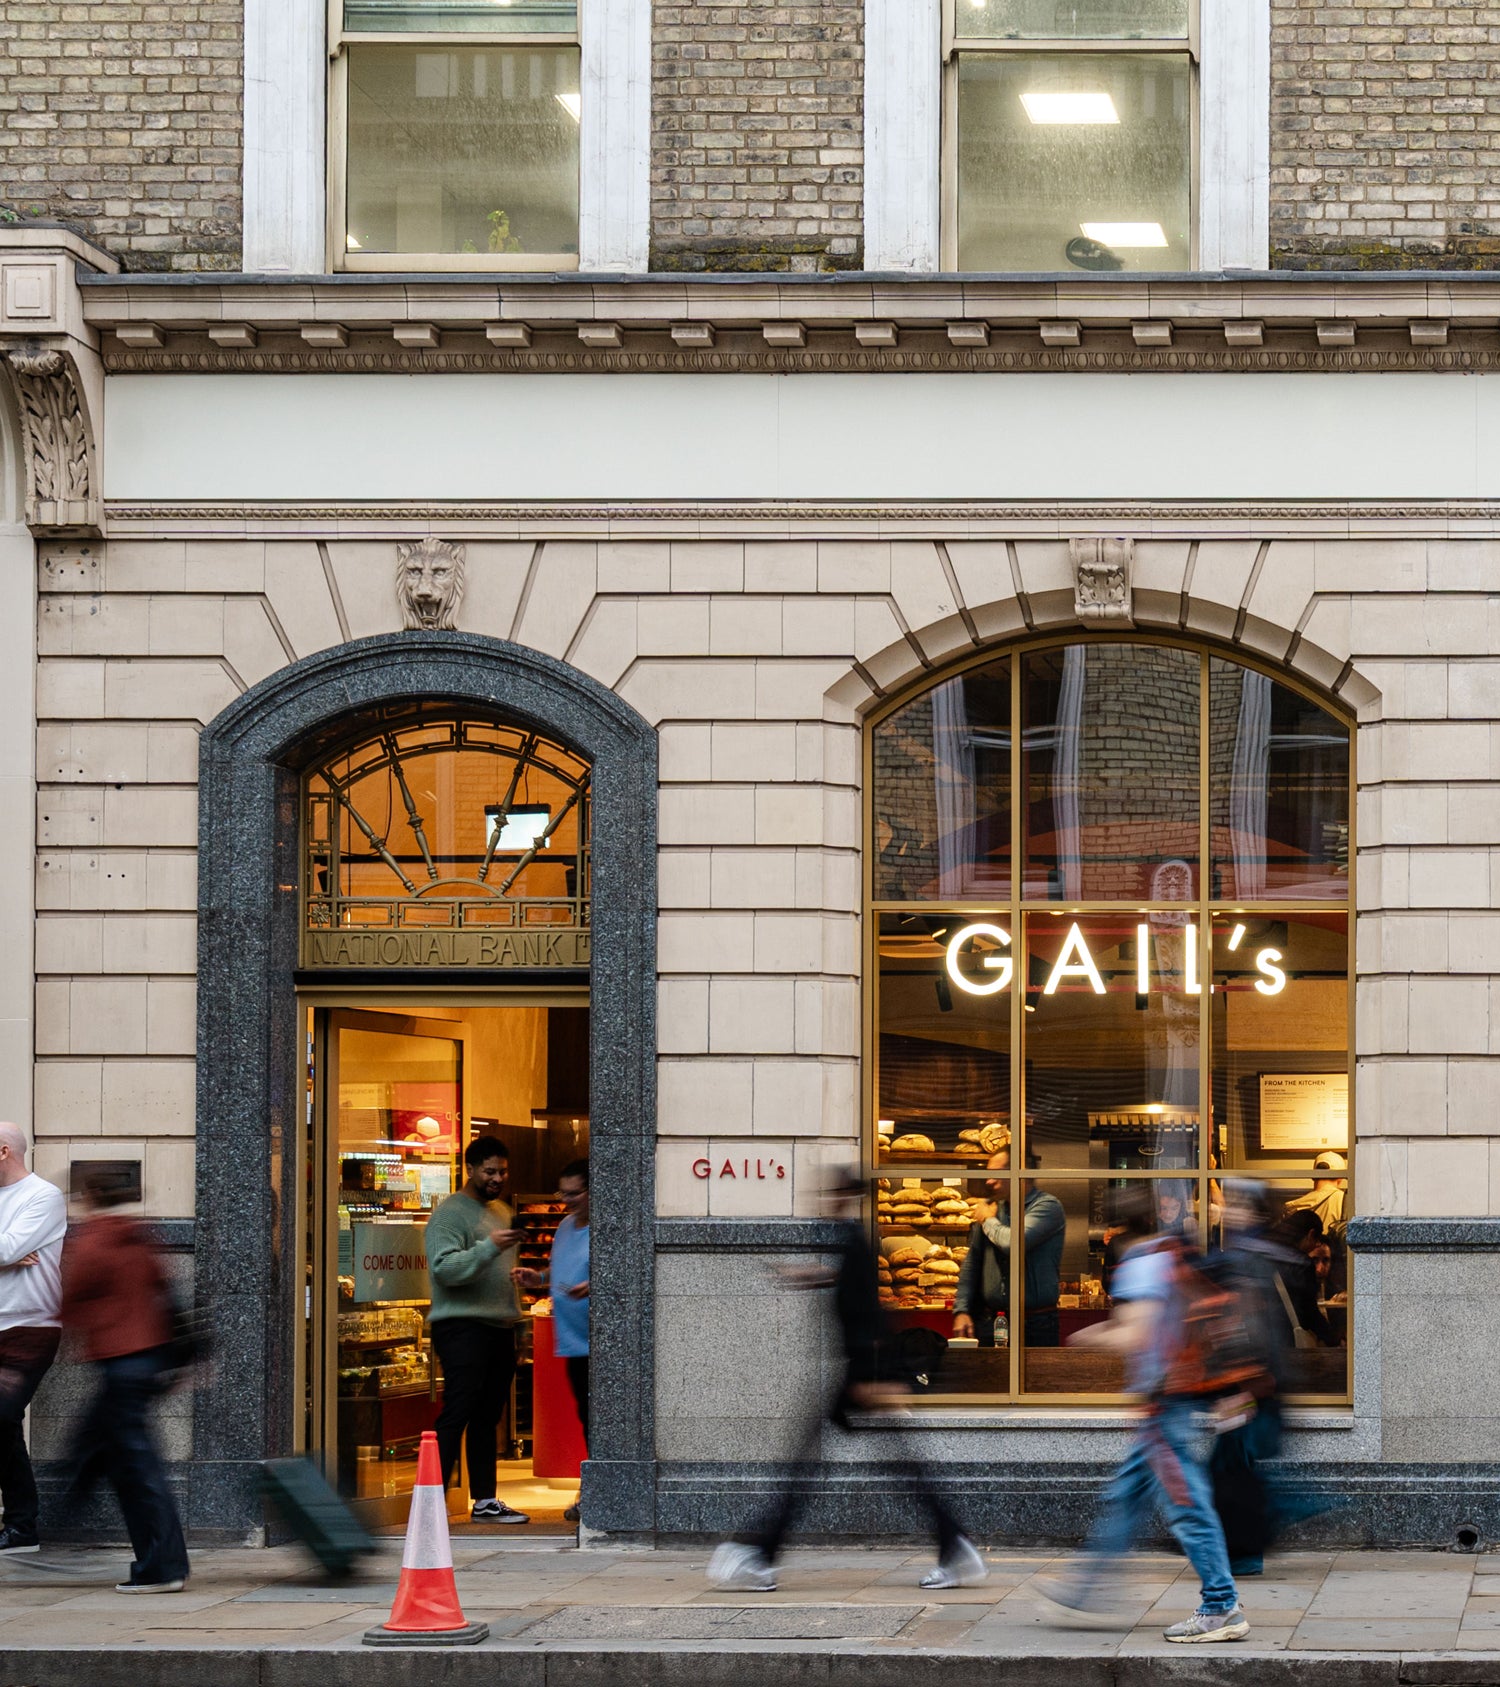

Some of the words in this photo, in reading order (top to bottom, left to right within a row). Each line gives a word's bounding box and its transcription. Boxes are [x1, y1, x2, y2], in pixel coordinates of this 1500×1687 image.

[312, 934, 469, 965] NATIONAL
[477, 934, 563, 965] BANK
[946, 922, 1286, 996] GAIL's
[692, 1158, 785, 1179] GAIL's
[363, 1255, 394, 1270] COME
[396, 1255, 412, 1270] ON
[414, 1255, 427, 1270] IN!
